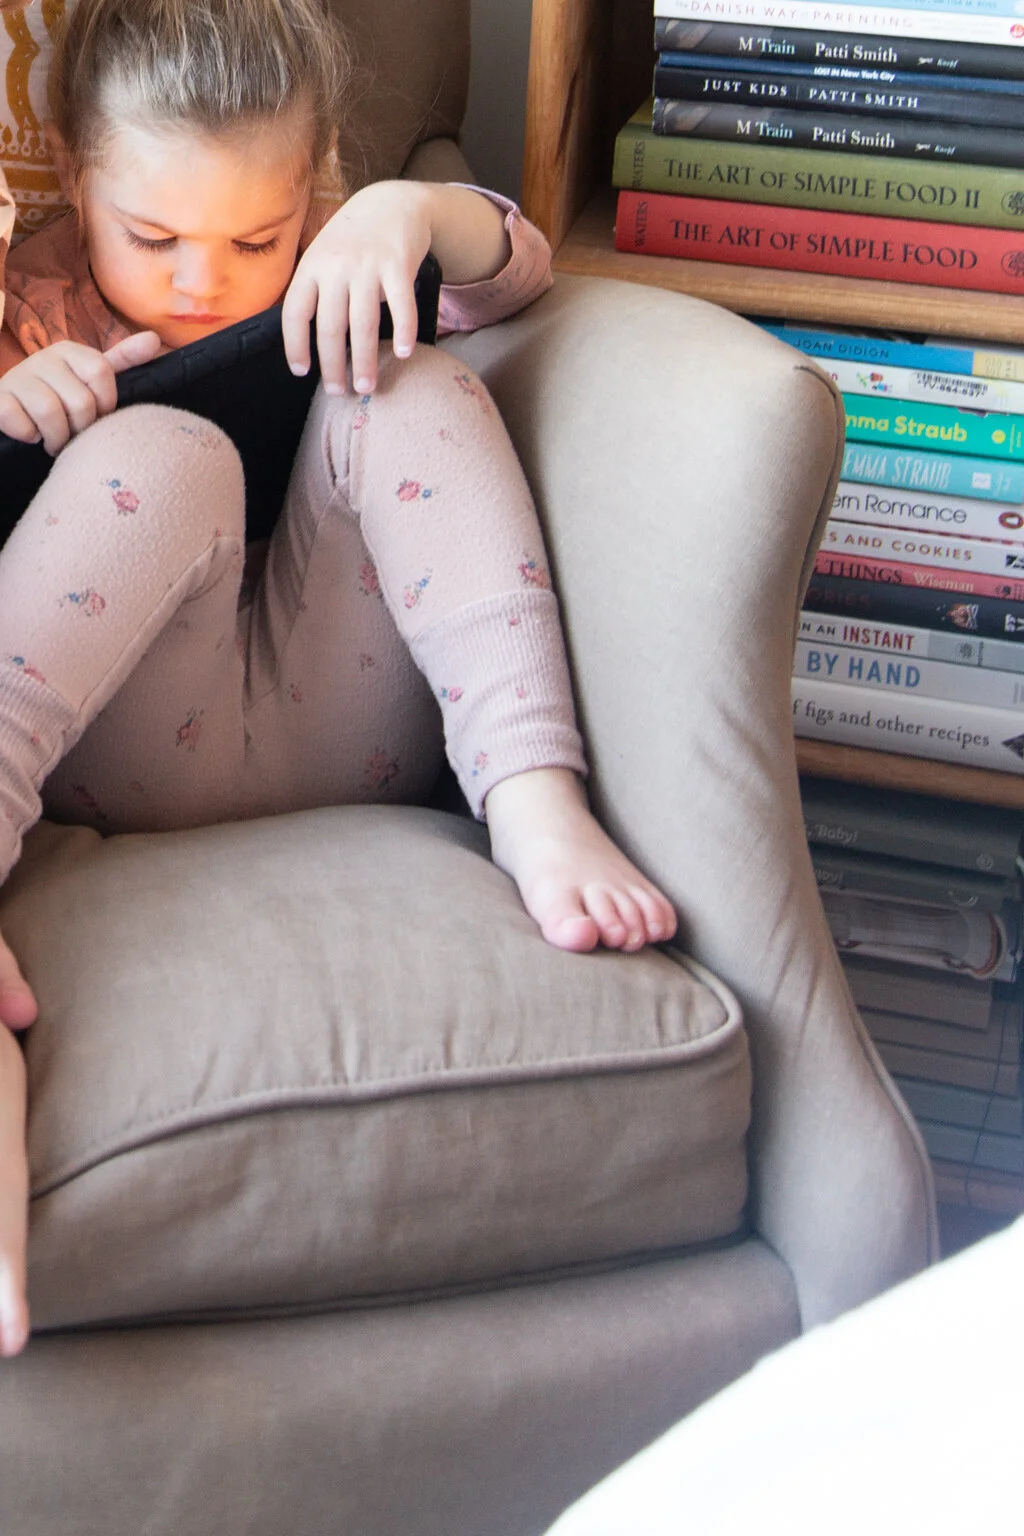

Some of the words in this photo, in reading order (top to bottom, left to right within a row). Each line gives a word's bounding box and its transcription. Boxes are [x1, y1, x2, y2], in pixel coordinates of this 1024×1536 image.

[690, 0, 756, 16] DANISH
[763, 6, 798, 19] WAY
[813, 9, 914, 29] PARENTING
[738, 37, 754, 51] M
[757, 38, 796, 55] Train
[815, 43, 851, 59] Patti
[853, 45, 898, 63] Smith
[841, 68, 860, 78] New
[860, 70, 878, 80] York
[703, 78, 741, 93] JUST
[749, 83, 788, 97] KIDS
[809, 89, 857, 103] PATTI
[864, 93, 919, 109] SMITH
[736, 119, 752, 134] M
[754, 120, 793, 139] Train
[813, 127, 847, 144] Patti
[849, 130, 895, 149] Smith
[664, 158, 704, 179] THE
[707, 163, 754, 185] ART
[760, 169, 790, 189] OF
[794, 172, 877, 200] SIMPLE
[883, 181, 957, 206] FOOD
[964, 188, 980, 208] II
[634, 201, 649, 248] WATERS
[670, 219, 712, 241] THE
[718, 225, 764, 248] ART
[769, 230, 800, 250] OF
[806, 233, 894, 262] SIMPLE
[902, 243, 979, 270] FOOD
[794, 338, 833, 352] JOAN
[838, 343, 890, 358] DIDION
[845, 415, 889, 432] mma
[894, 415, 967, 443] Straub
[844, 449, 887, 482] EMMA
[892, 456, 953, 490] STRAUB
[833, 496, 860, 511] ern
[865, 495, 968, 524] Romance
[844, 533, 883, 549] AND
[891, 536, 973, 561] COOKIES
[828, 560, 903, 584] THINGS
[912, 571, 975, 593] Wiseman
[816, 624, 836, 636] AN
[843, 624, 916, 651] INSTANT
[807, 650, 839, 675] BY
[848, 656, 921, 688] HAND
[806, 700, 834, 726] figs
[838, 710, 872, 727] and
[876, 715, 925, 736] other
[928, 725, 990, 750] recipes
